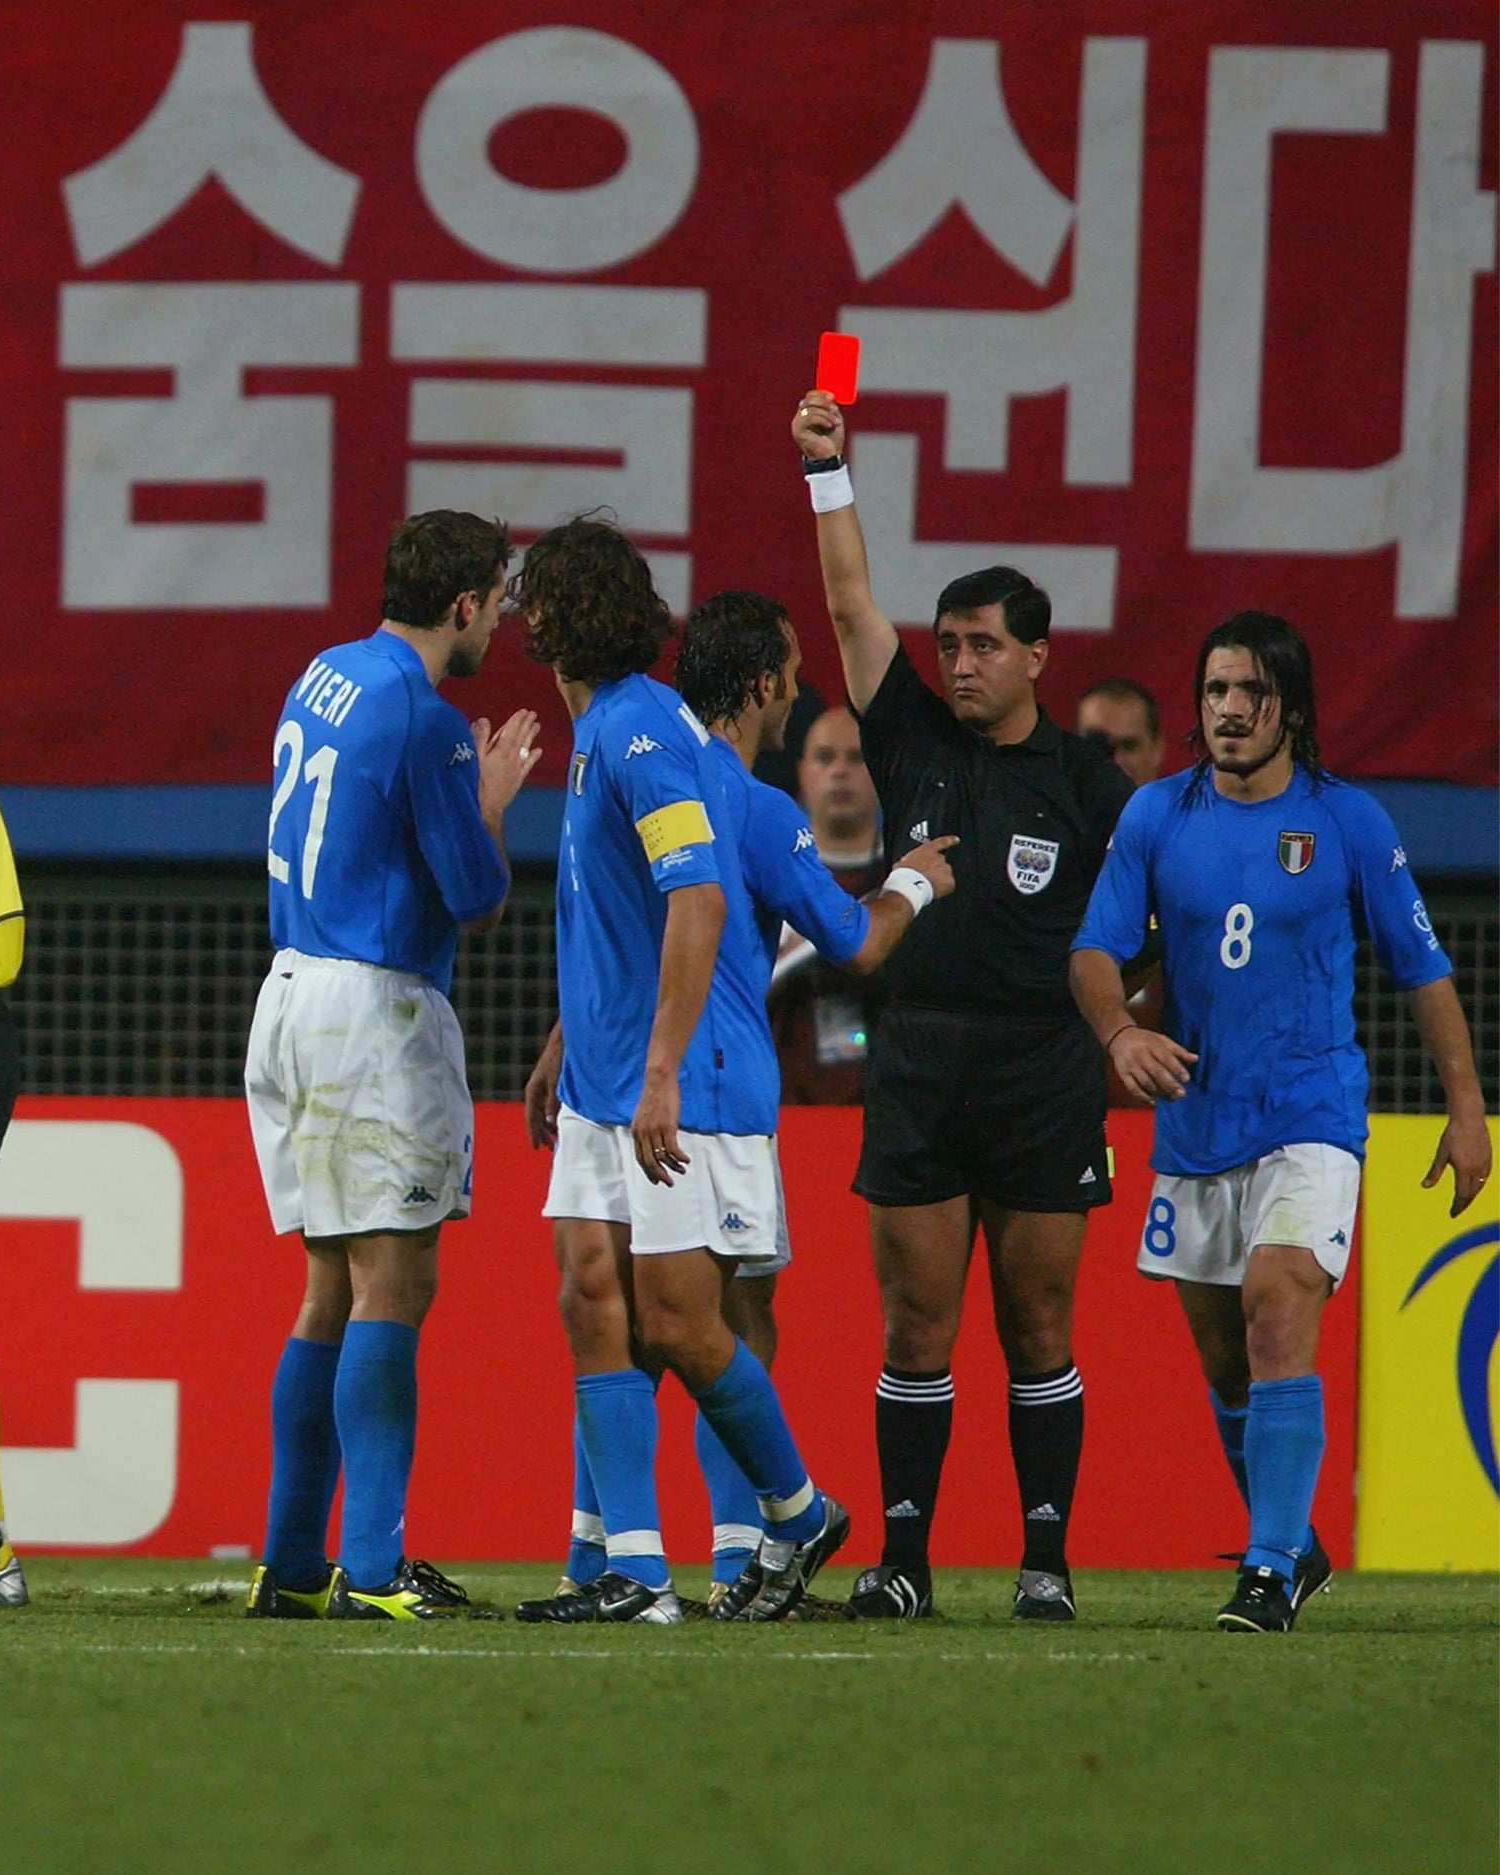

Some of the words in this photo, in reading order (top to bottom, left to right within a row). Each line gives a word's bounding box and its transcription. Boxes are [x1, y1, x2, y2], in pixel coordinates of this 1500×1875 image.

[59, 21, 707, 619] 숨을
[836, 36, 1498, 631] 쉰다
[295, 657, 362, 728] VIERI
[267, 720, 339, 900] 21
[1016, 870, 1040, 884] FIFA
[1220, 902, 1254, 970] 8
[1144, 1196, 1177, 1258] 8
